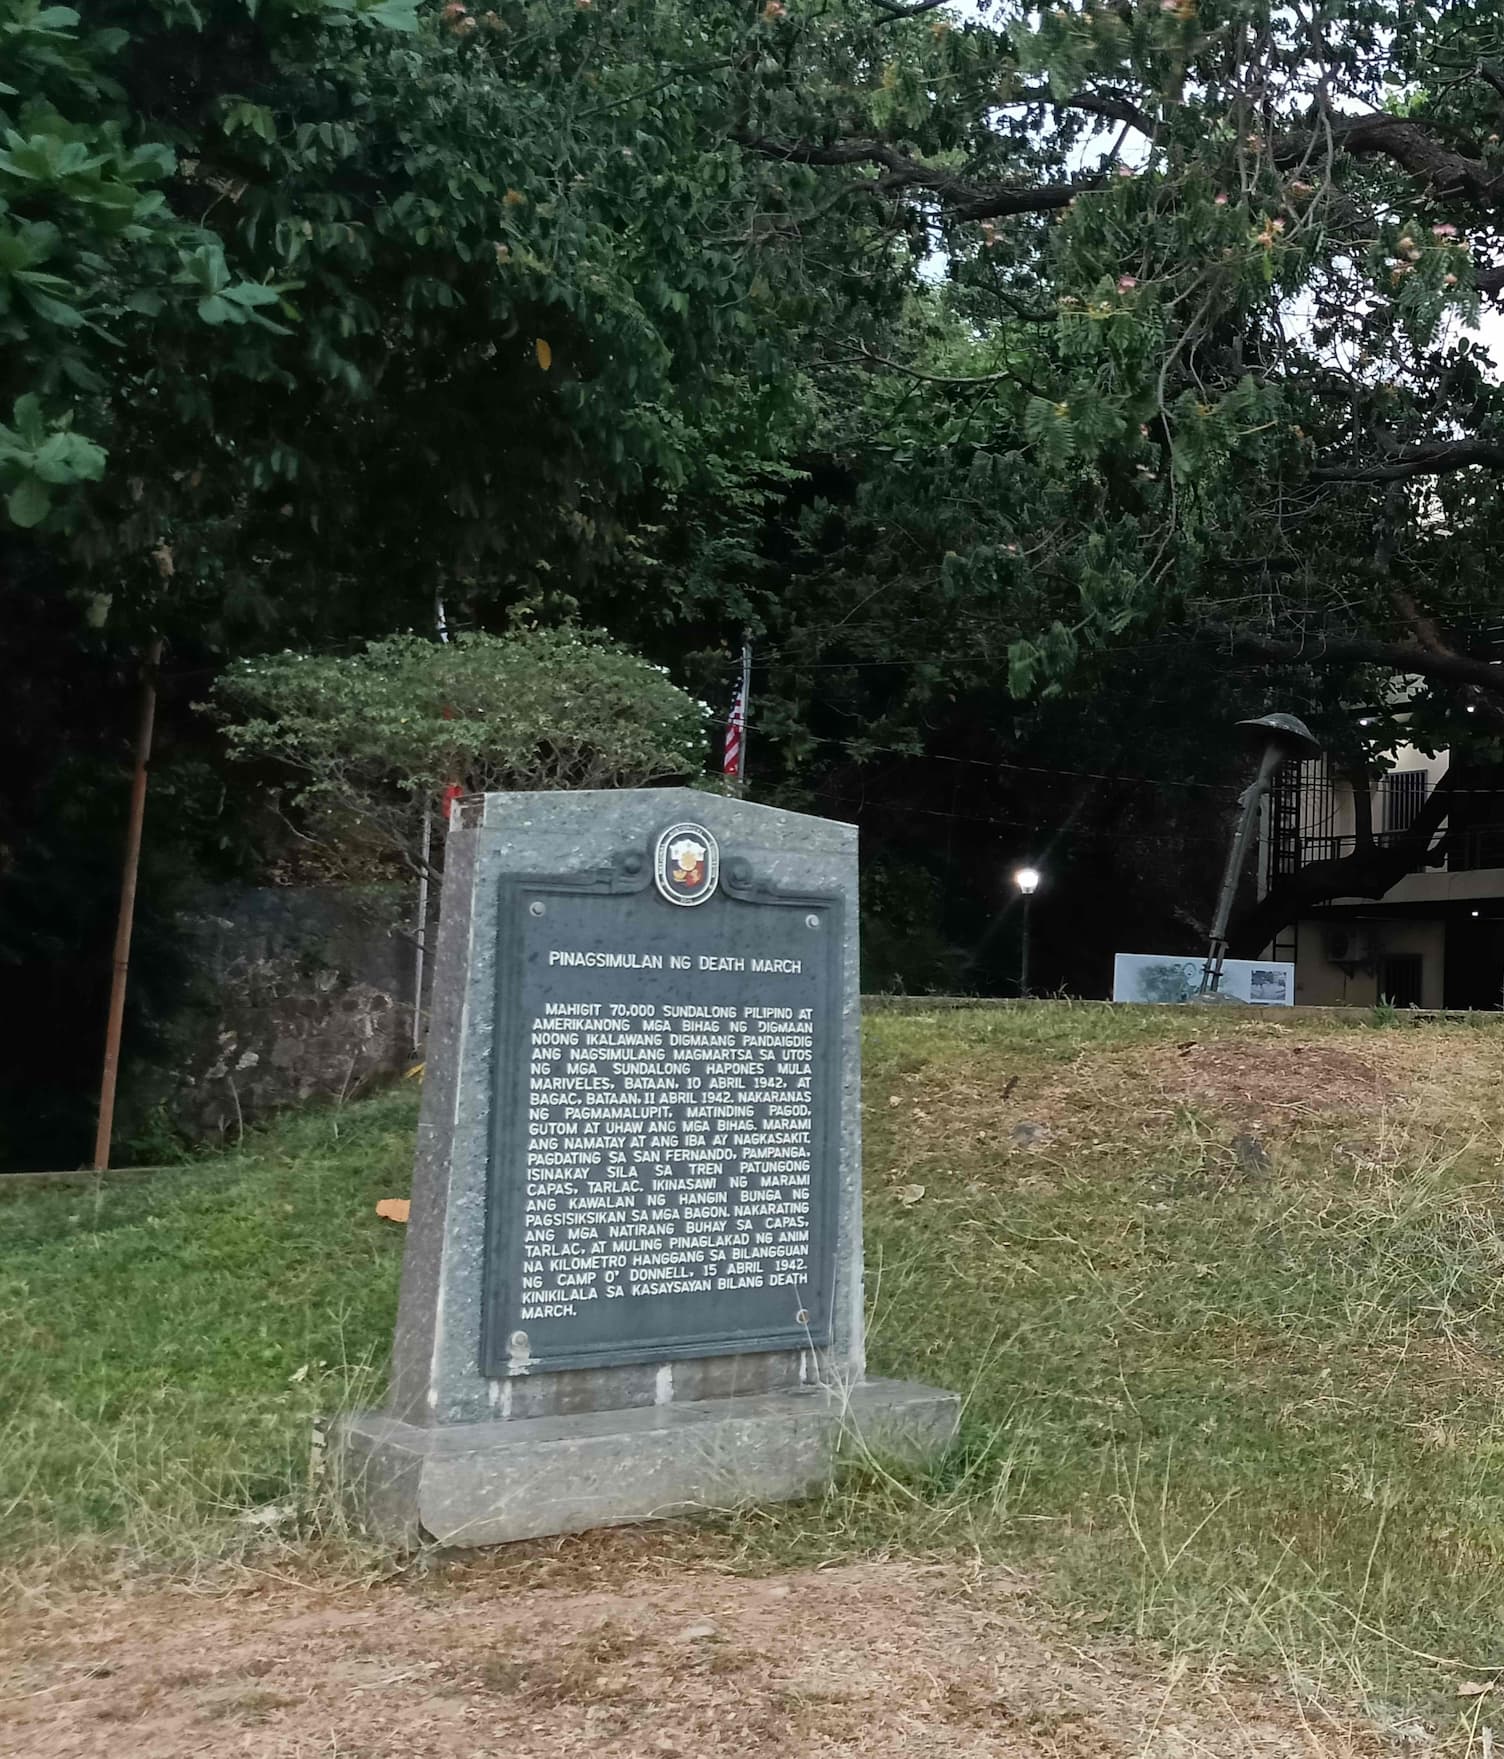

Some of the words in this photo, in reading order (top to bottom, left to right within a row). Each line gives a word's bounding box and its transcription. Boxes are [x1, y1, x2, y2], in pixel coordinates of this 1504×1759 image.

[549, 951, 662, 968] PINAGSIMULAN
[670, 956, 691, 969] NG
[699, 956, 744, 971] DEATH
[751, 959, 801, 973] MARCH
[546, 1003, 602, 1016] MAHIGIT
[610, 1004, 655, 1016] 70,000
[662, 1005, 736, 1018] SUNDALONG
[744, 1007, 792, 1019] PILIPINO
[798, 1008, 813, 1019] AT
[533, 1019, 630, 1033] AMERIKANONG
[643, 1020, 671, 1031] MGA
[682, 1020, 719, 1032] BIHAG
[729, 1021, 747, 1032] NG
[758, 1021, 812, 1033] DIGMAAN
[532, 1033, 579, 1045] NOONG
[586, 1034, 662, 1045] IKALAWANG
[670, 1034, 735, 1046] DIGMAANG
[743, 1035, 812, 1047] PANDAIGDIG
[532, 1048, 561, 1060] ANG
[570, 1048, 665, 1060] NAGSIMULANG
[673, 1049, 753, 1060] MAGMARTSA
[759, 1049, 775, 1060] SA
[782, 1049, 812, 1060] UTOS
[530, 1063, 550, 1074] NG
[567, 1063, 597, 1074] MGA
[613, 1062, 690, 1075] SUNDALONG
[706, 1063, 764, 1074] HAPONES
[778, 1063, 812, 1074] MULA
[530, 1077, 615, 1090] MARIVELES,
[624, 1077, 679, 1089] BATAAN,
[687, 1077, 701, 1089] 10
[709, 1077, 745, 1089] ABRIL
[754, 1077, 787, 1088] 1942,
[797, 1077, 811, 1088] AT
[530, 1093, 582, 1105] BAGAC,
[586, 1092, 642, 1105] BATAAN,
[659, 1092, 697, 1104] ABRIL
[702, 1091, 734, 1103] 1942.
[738, 1091, 811, 1103] NAKARANAS
[529, 1108, 549, 1120] NG
[686, 1105, 754, 1117] MATINDING
[769, 1105, 811, 1116] PAGOD,
[529, 1122, 577, 1135] GUTOM
[584, 1122, 600, 1134] AT
[606, 1121, 643, 1134] UHAW
[648, 1121, 676, 1133] ANG
[682, 1120, 710, 1132] MGA
[717, 1120, 757, 1131] BIHAG.
[763, 1119, 811, 1130] MARAMI
[528, 1138, 558, 1150] ANG
[564, 1136, 626, 1149] NAMATAY
[630, 1135, 646, 1148] AT
[650, 1135, 678, 1147] ANG
[685, 1134, 706, 1146] IBA
[712, 1134, 728, 1145] AY
[734, 1132, 810, 1145] NAGKASAKIT.
[527, 1152, 601, 1166] PAGDATING
[608, 1151, 626, 1163] SA
[633, 1150, 660, 1162] SAN
[665, 1148, 737, 1161] FERNANDO,
[742, 1147, 810, 1159] PAMPANGA,
[527, 1167, 590, 1181] ISINAKAY
[606, 1166, 638, 1178] SILA
[654, 1164, 672, 1176] SA
[688, 1163, 722, 1175] TREN
[740, 1160, 810, 1173] PATUNGONG
[527, 1182, 578, 1196] CAPAS,
[652, 1178, 716, 1191] IKINASAWI
[729, 1176, 747, 1188] NG
[761, 1174, 810, 1187] MARAMI
[526, 1198, 556, 1212] ANG
[569, 1195, 634, 1209] KAWALAN
[647, 1194, 665, 1206] NG
[679, 1192, 727, 1205] HANGIN
[741, 1190, 782, 1202] BUNGA
[793, 1188, 809, 1199] NG
[525, 1211, 626, 1227] PAGSISIKSIKAN
[631, 1210, 648, 1221] SA
[652, 1209, 680, 1220] MGA
[684, 1206, 730, 1219] BAGON.
[734, 1202, 809, 1216] NAKARATING
[524, 1229, 555, 1242] ANG
[568, 1227, 598, 1240] MGA
[609, 1223, 674, 1237] NATIRANG
[686, 1221, 727, 1233] BUHAY
[737, 1219, 752, 1230] SA
[765, 1216, 809, 1229] CAPAS,
[525, 1243, 585, 1257] TARLAC,
[591, 1241, 607, 1254] AT
[613, 1238, 662, 1252] MULING
[669, 1233, 749, 1249] PINAGLAKAD
[755, 1232, 773, 1243] NG
[779, 1230, 808, 1242] ANIM
[524, 1261, 544, 1273] NA
[550, 1255, 626, 1271] KILOMETRO
[632, 1251, 704, 1266] HANGGANG
[710, 1249, 726, 1261] SA
[732, 1245, 808, 1259] BILANGGUAN
[522, 1276, 542, 1288] NG
[557, 1272, 596, 1286] CAMP
[630, 1267, 694, 1281] DONNELL,
[704, 1264, 717, 1276] 15
[726, 1262, 763, 1274] ABRIL
[776, 1258, 807, 1271] 1942.
[522, 1288, 598, 1304] KINIKILALA
[606, 1285, 624, 1297] SA
[632, 1280, 711, 1296] KASAYSAYAN
[718, 1276, 763, 1289] BILANG
[769, 1273, 807, 1287] DEATH
[521, 1304, 576, 1319] MARCH.
